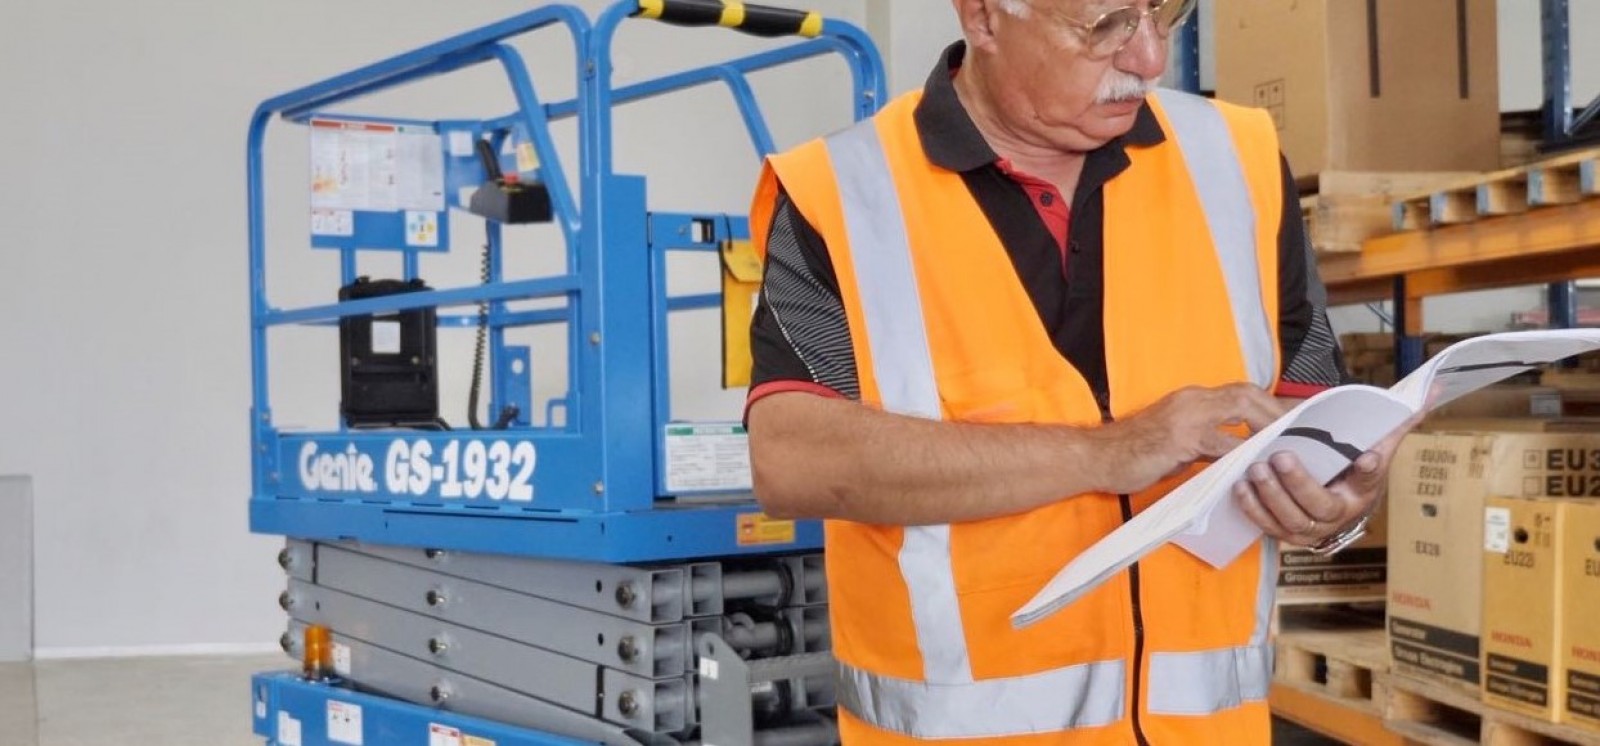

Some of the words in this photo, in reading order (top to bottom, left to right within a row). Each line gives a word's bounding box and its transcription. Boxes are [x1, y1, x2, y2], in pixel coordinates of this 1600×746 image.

[300, 441, 377, 491] Genie
[386, 439, 536, 501] GS-1932
[1491, 630, 1533, 648] HONDA
